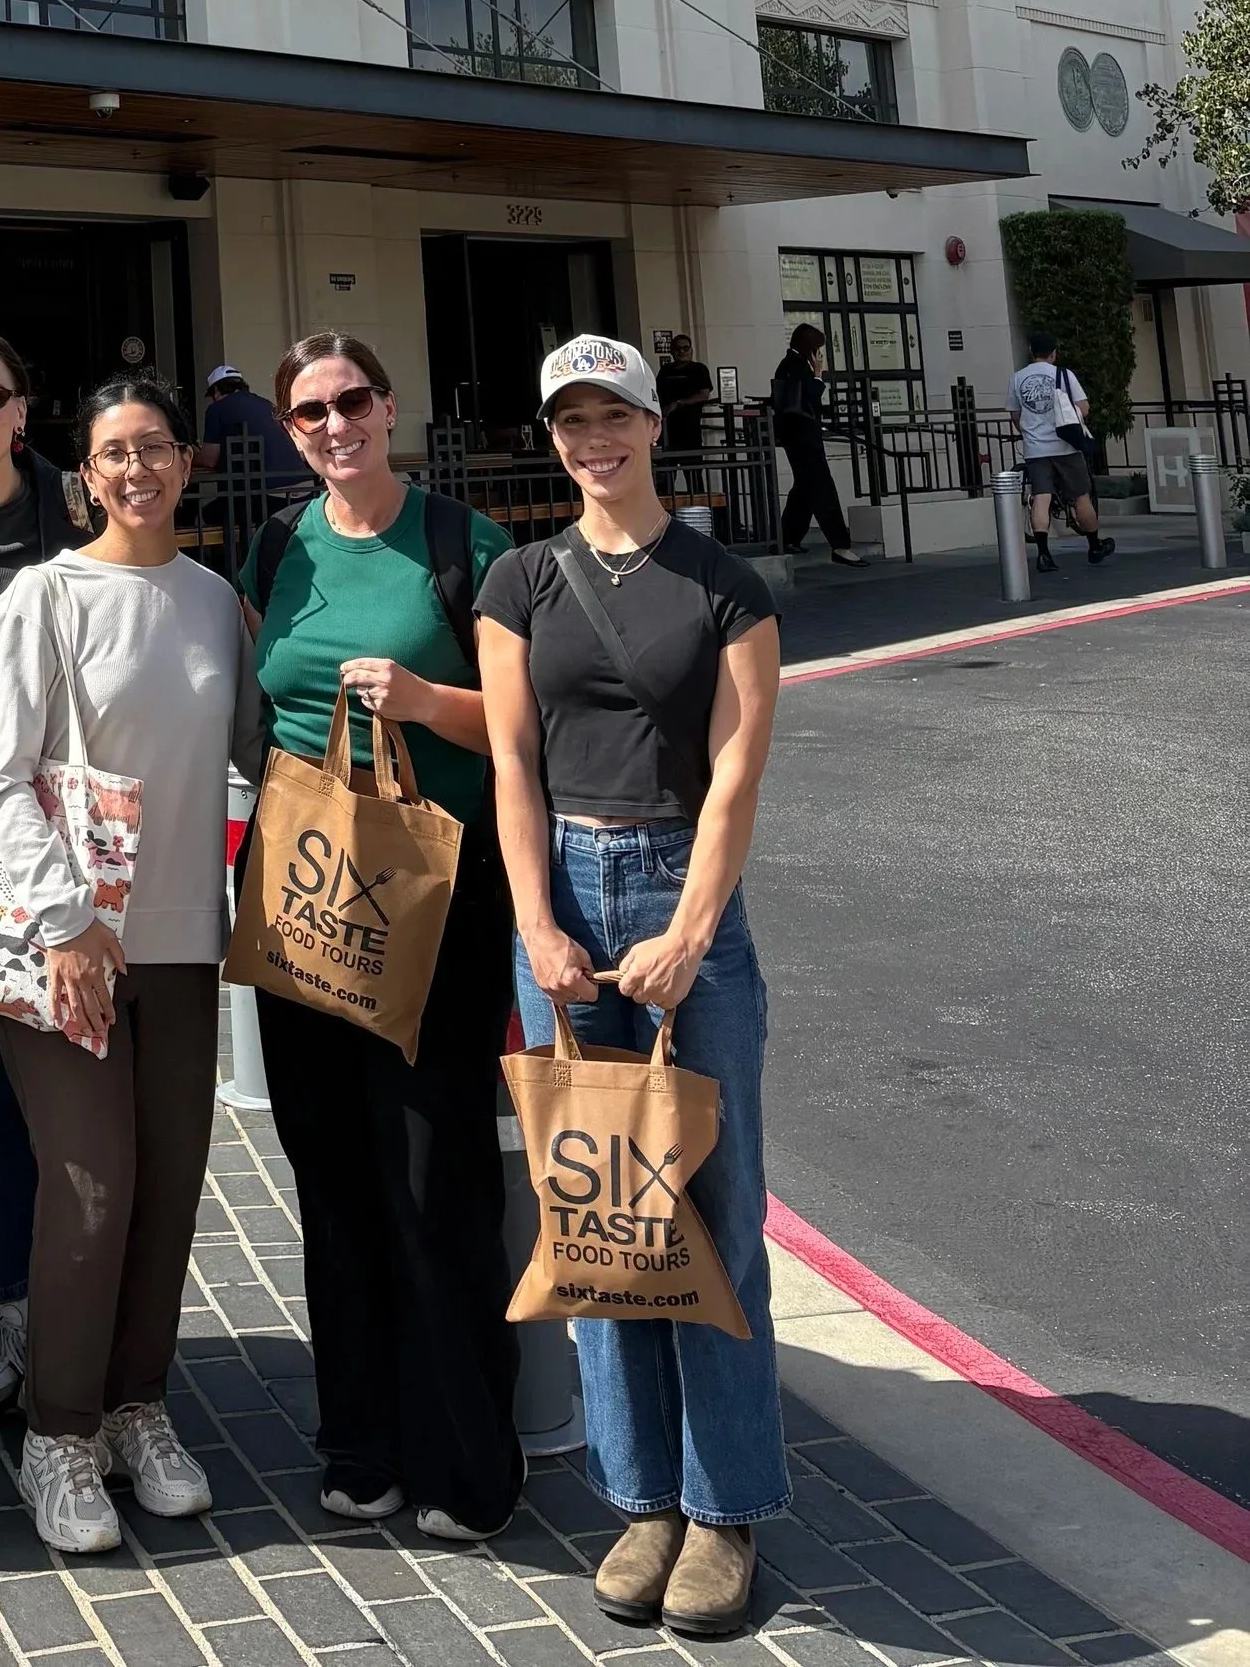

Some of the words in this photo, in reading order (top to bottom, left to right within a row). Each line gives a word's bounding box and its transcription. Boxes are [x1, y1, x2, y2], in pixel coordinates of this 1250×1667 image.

[506, 204, 543, 226] 3229
[288, 829, 397, 927] SIX
[274, 914, 315, 951] FOOD
[320, 941, 384, 976] TOURS
[280, 886, 389, 956] TASTE
[266, 949, 377, 1011] sixtaste.com
[548, 1130, 684, 1210] SIX
[550, 1206, 685, 1249] TASTE
[553, 1242, 613, 1267] FOOD
[619, 1247, 690, 1272] TOURS
[556, 1283, 700, 1308] sixtaste.com
